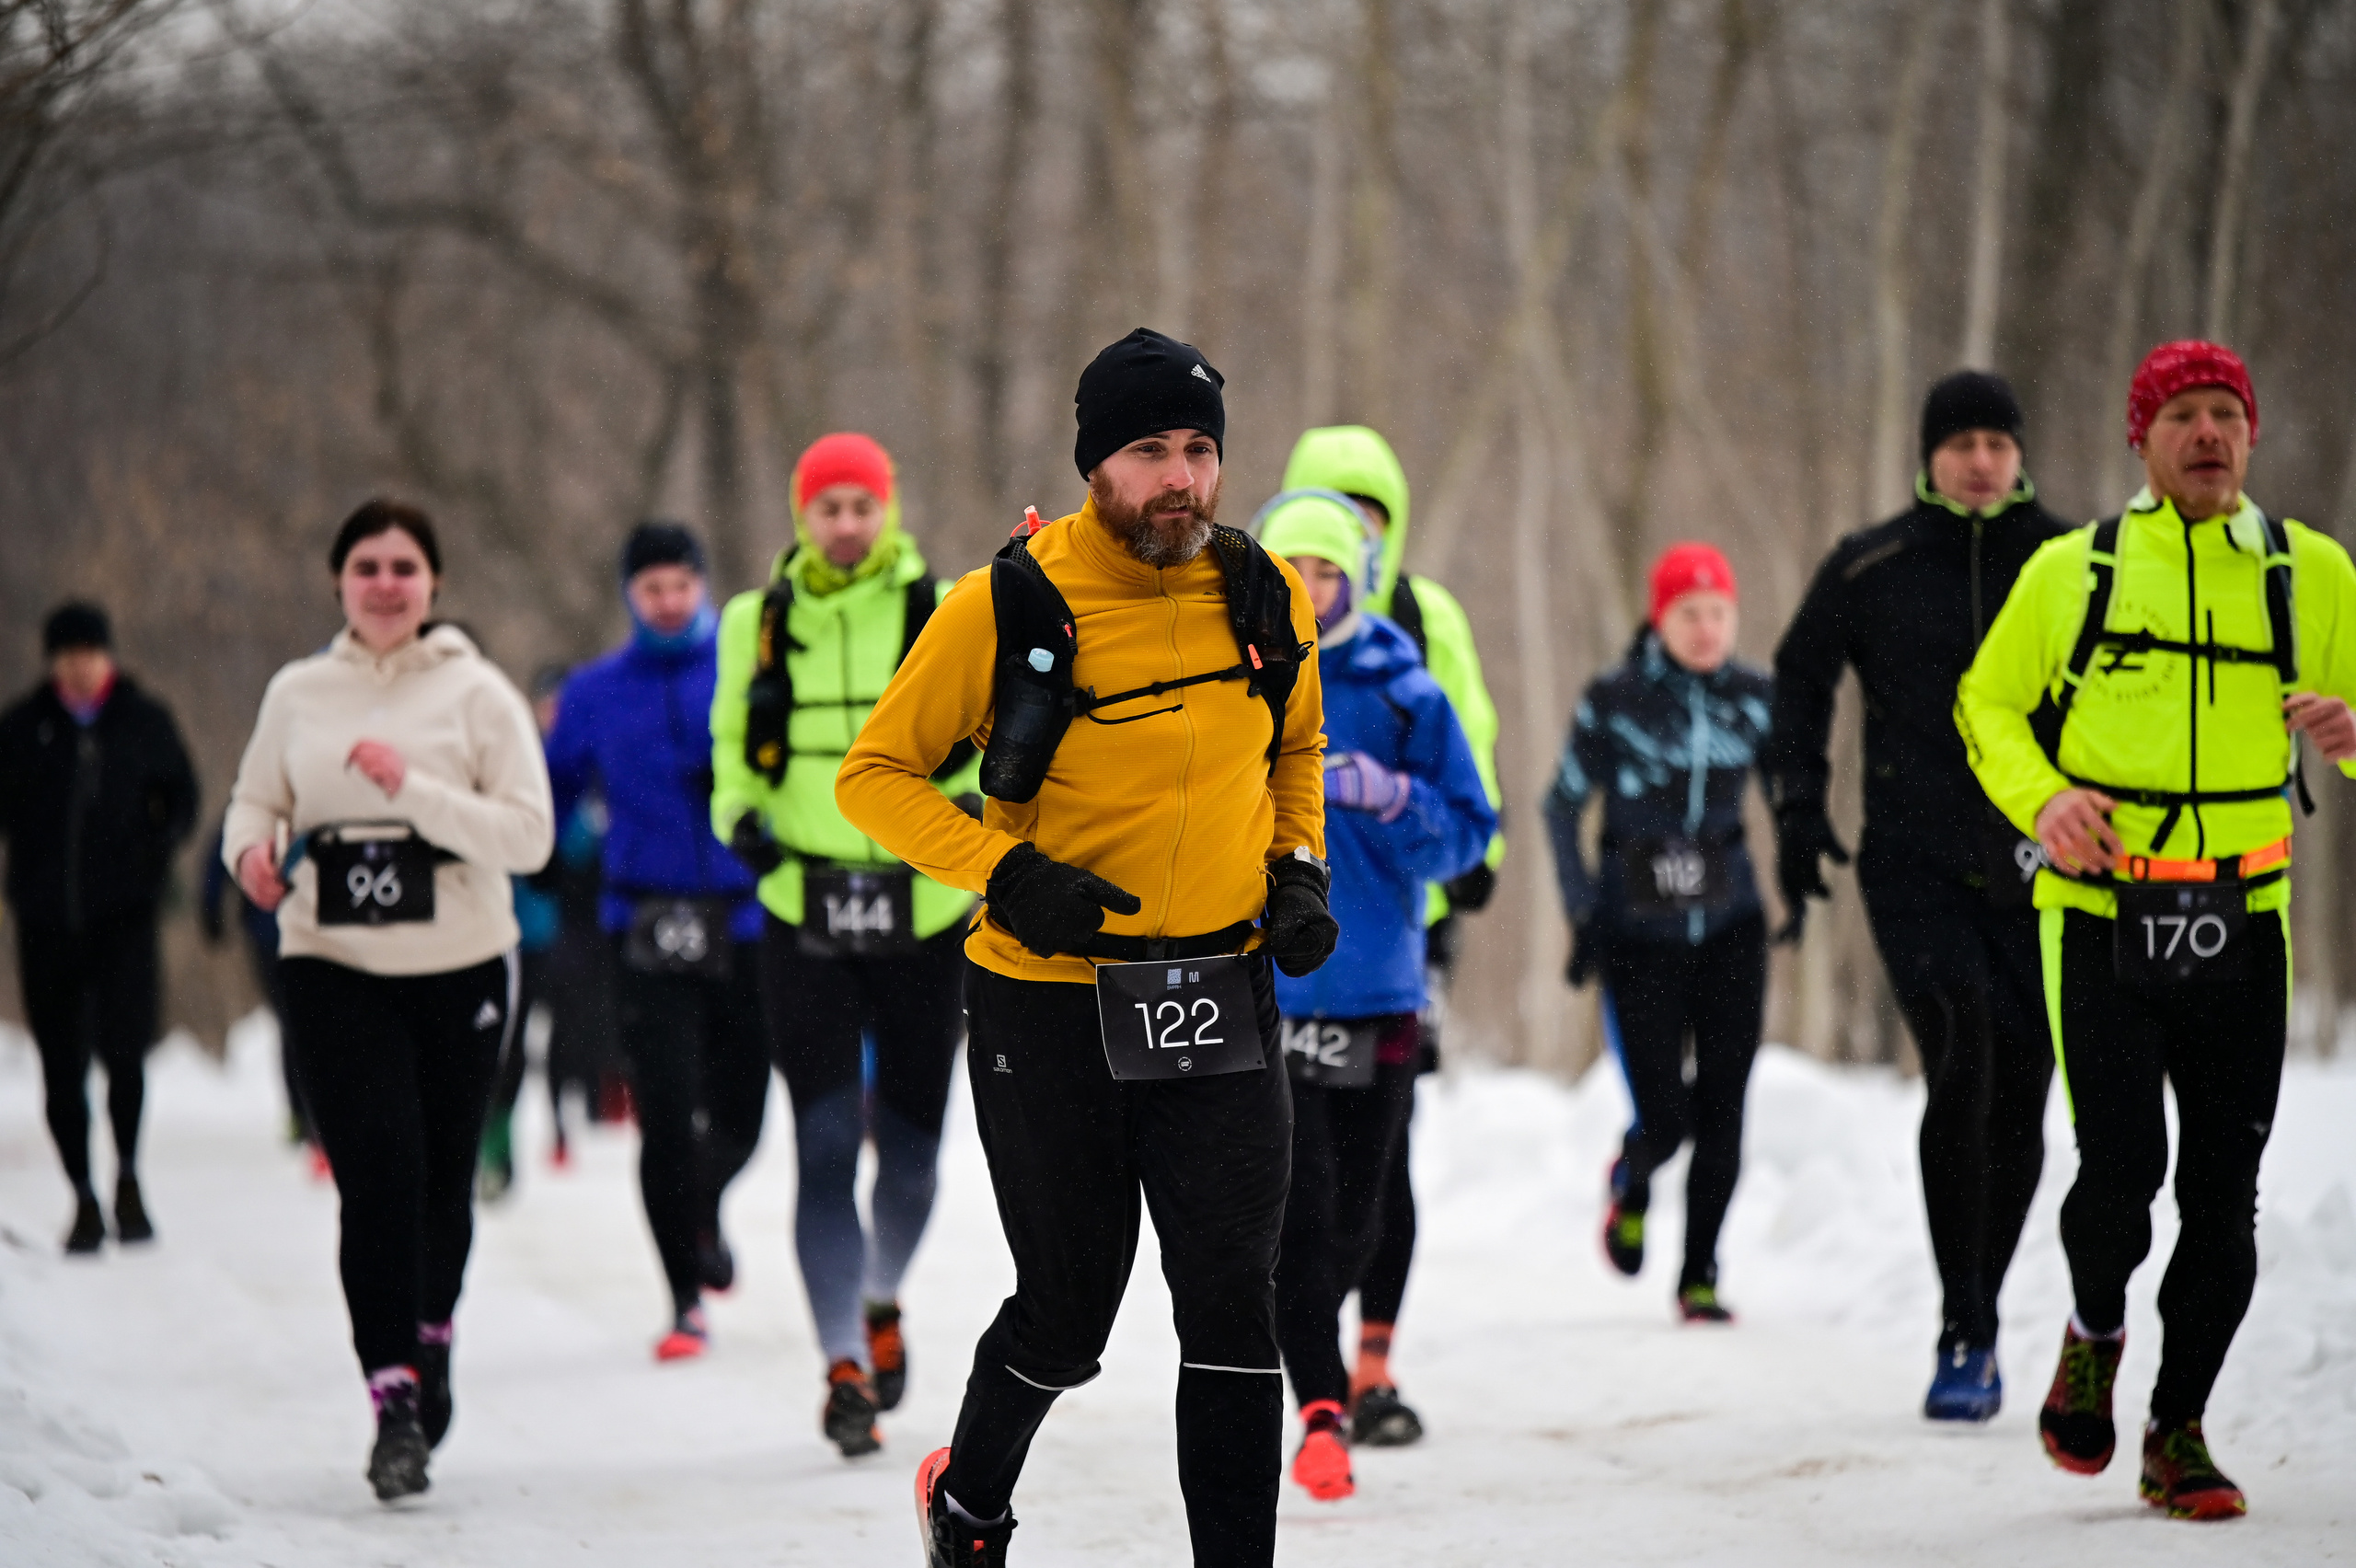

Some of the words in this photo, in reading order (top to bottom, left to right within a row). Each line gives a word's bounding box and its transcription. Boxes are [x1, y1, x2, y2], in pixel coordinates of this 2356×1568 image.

[2014, 838, 2050, 883] 9
[346, 862, 403, 908] 96
[823, 894, 894, 938] 144
[2140, 914, 2227, 961] 170
[1134, 997, 1224, 1050] 122
